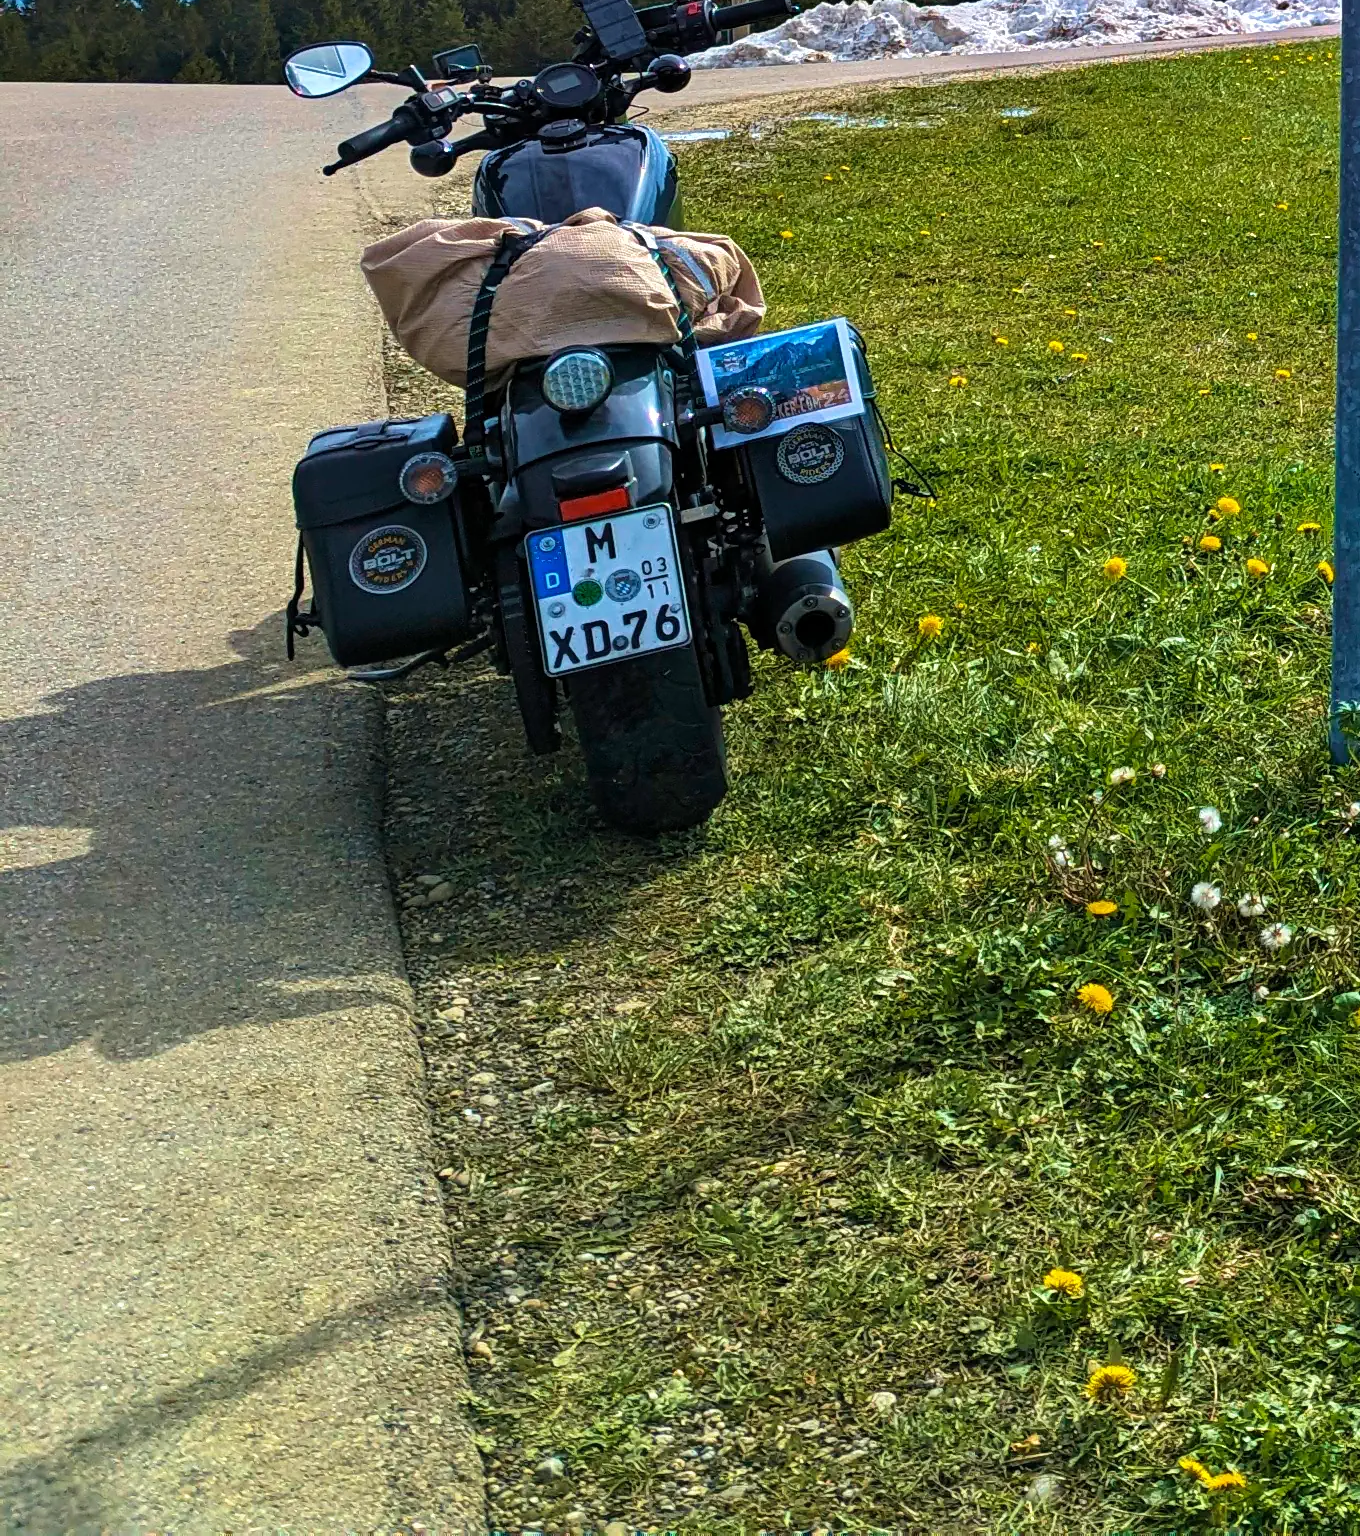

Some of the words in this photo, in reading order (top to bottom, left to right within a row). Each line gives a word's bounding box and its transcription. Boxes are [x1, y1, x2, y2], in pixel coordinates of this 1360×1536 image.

[787, 444, 832, 464] BOLT
[585, 522, 617, 564] M
[363, 548, 416, 570] BOLT
[641, 557, 668, 575] 03
[545, 572, 560, 589] D
[647, 580, 669, 599] 11
[549, 619, 612, 669] XD
[622, 603, 681, 650] 76
